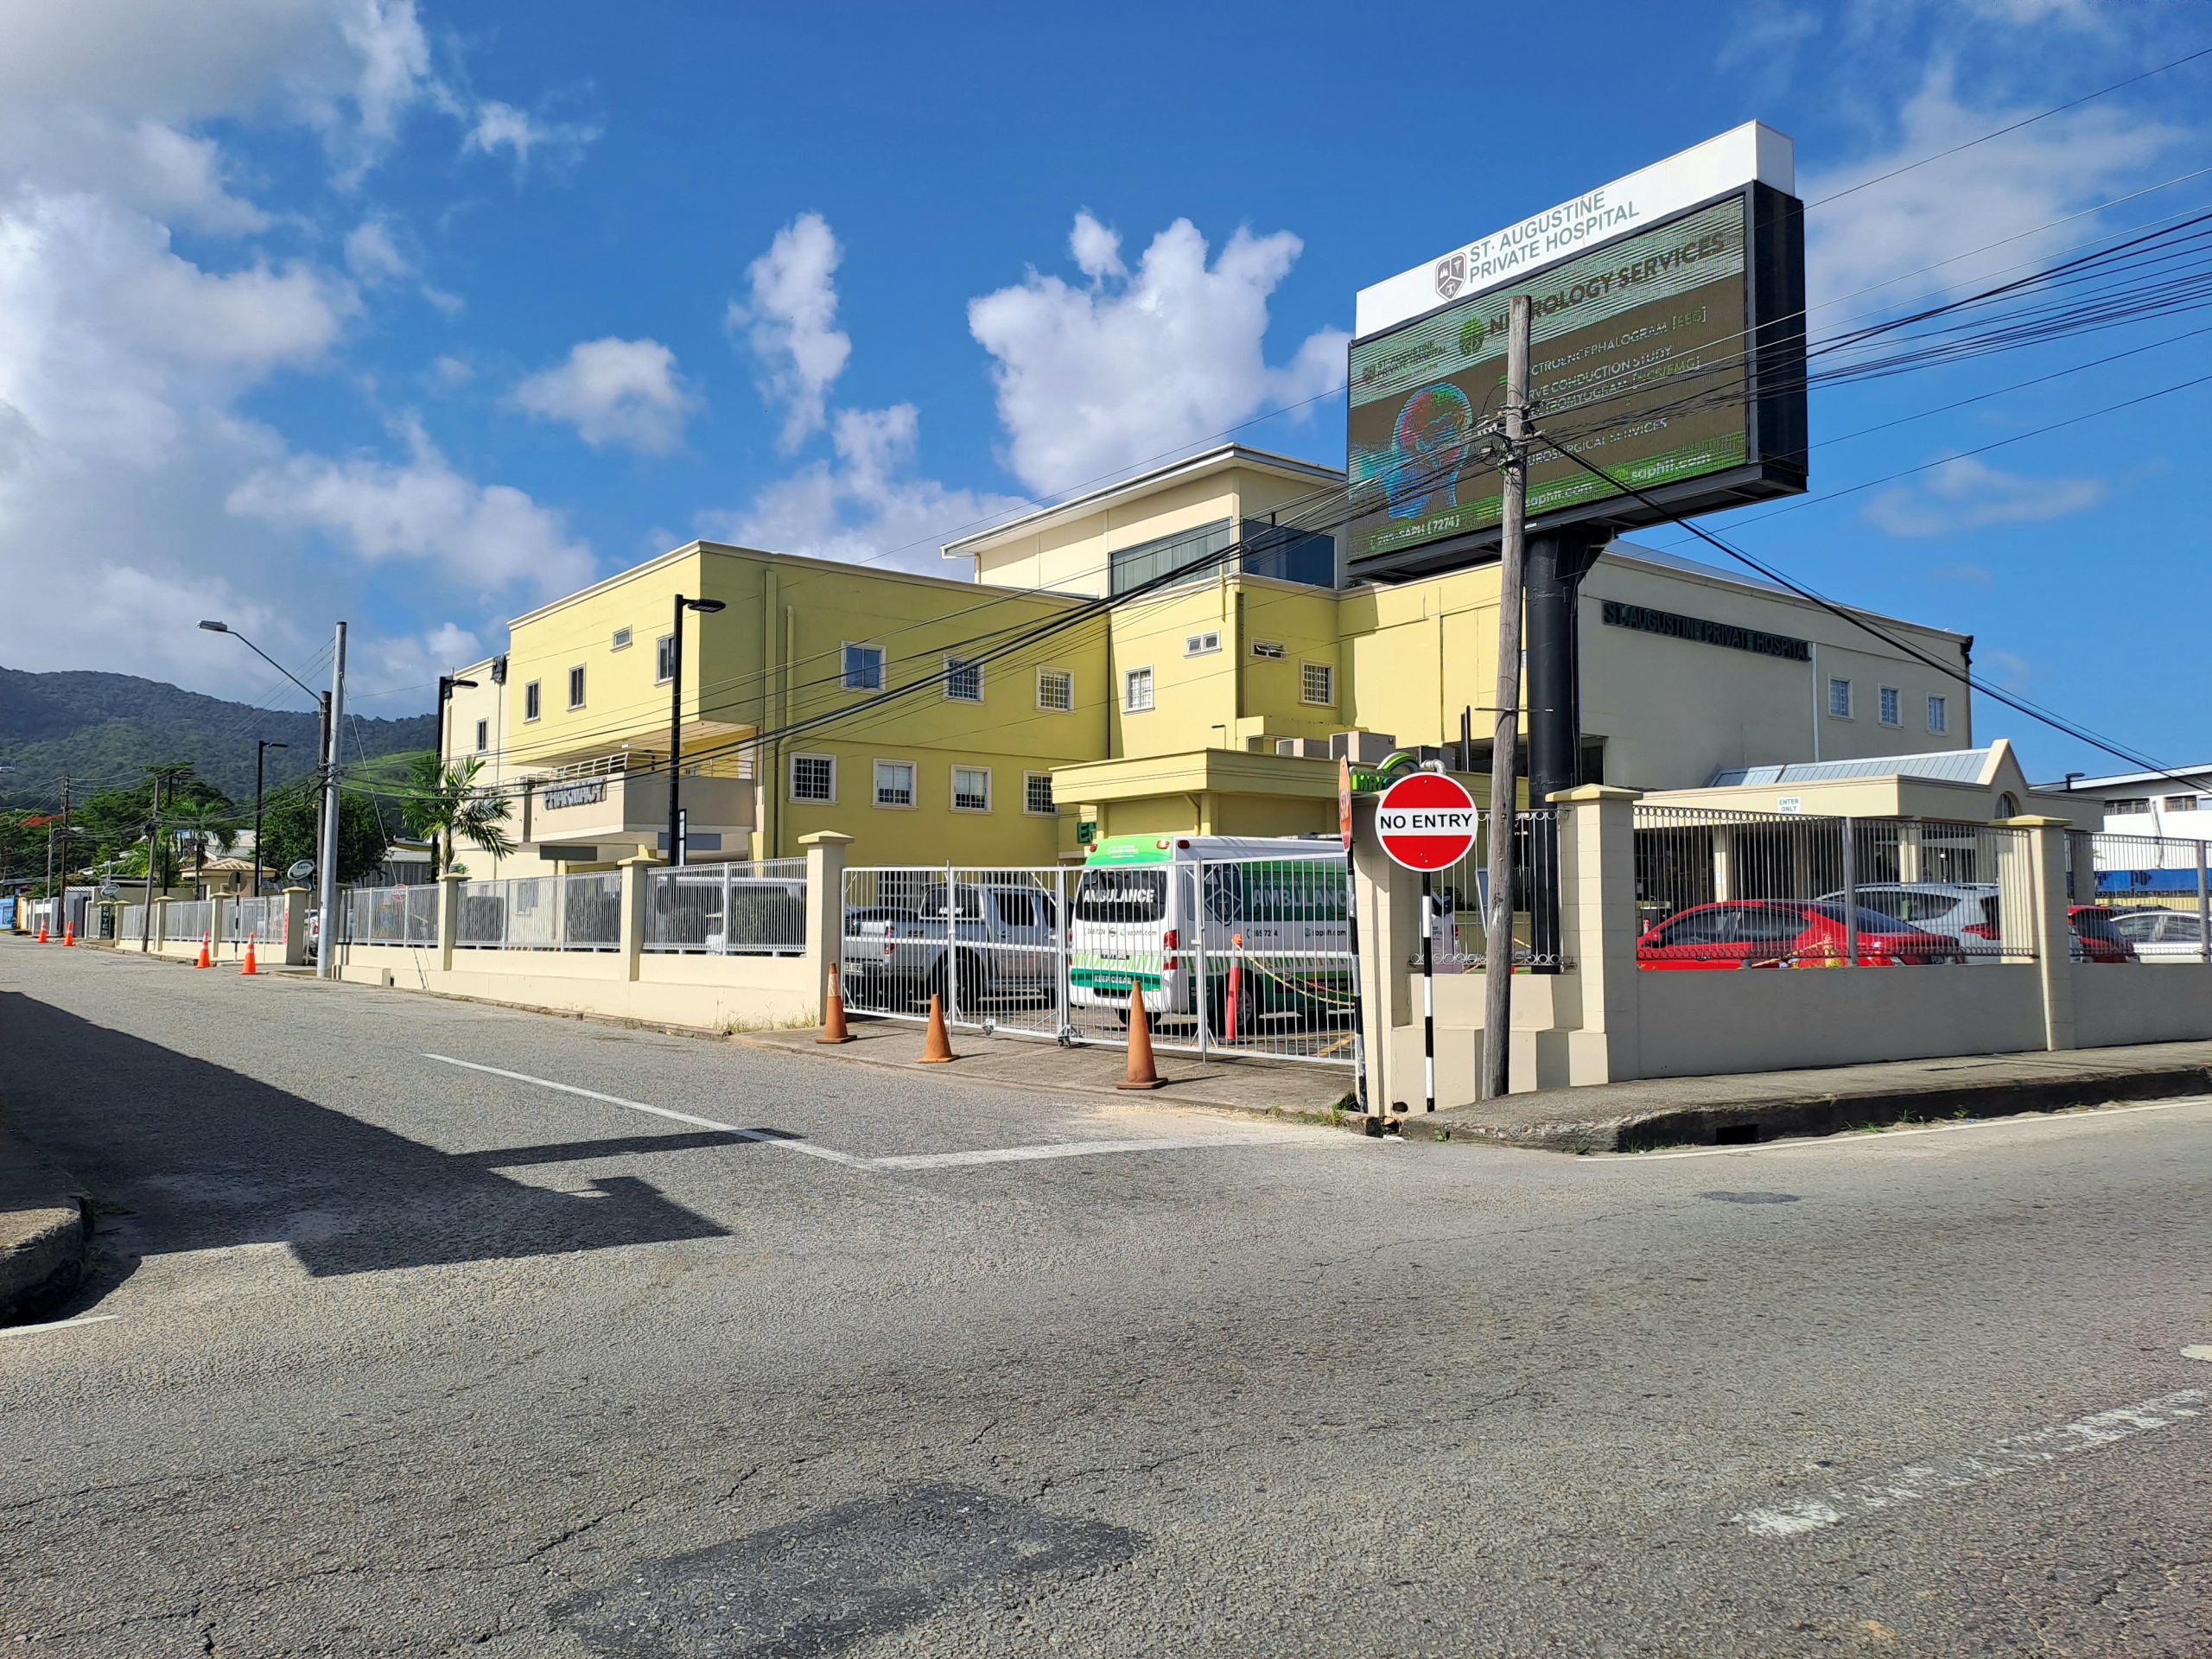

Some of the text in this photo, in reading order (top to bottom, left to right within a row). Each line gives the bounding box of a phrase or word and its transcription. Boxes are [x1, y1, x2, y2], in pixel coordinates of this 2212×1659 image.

[1470, 190, 1605, 263] ST. AUGUSTINE
[1470, 200, 1640, 283] PRIVATE HOSPITAL
[1490, 232, 1726, 335] NROLOGY SERVICES
[1529, 384, 1549, 401] RVE
[1551, 358, 1631, 393] CONDUCTION
[1628, 607, 1702, 642] AUGUSTINE
[1705, 621, 1755, 652] PRIVATE
[1756, 632, 1812, 663] HOSPITAL
[543, 776, 607, 810] PHARMACY
[1381, 813, 1473, 830] NO ENTRY
[1084, 888, 1155, 903] AMBULANCE
[1253, 888, 1347, 907] AMBULANC
[101, 906, 111, 937] ENTER
[1094, 975, 1132, 985] KEEP CLEAR
